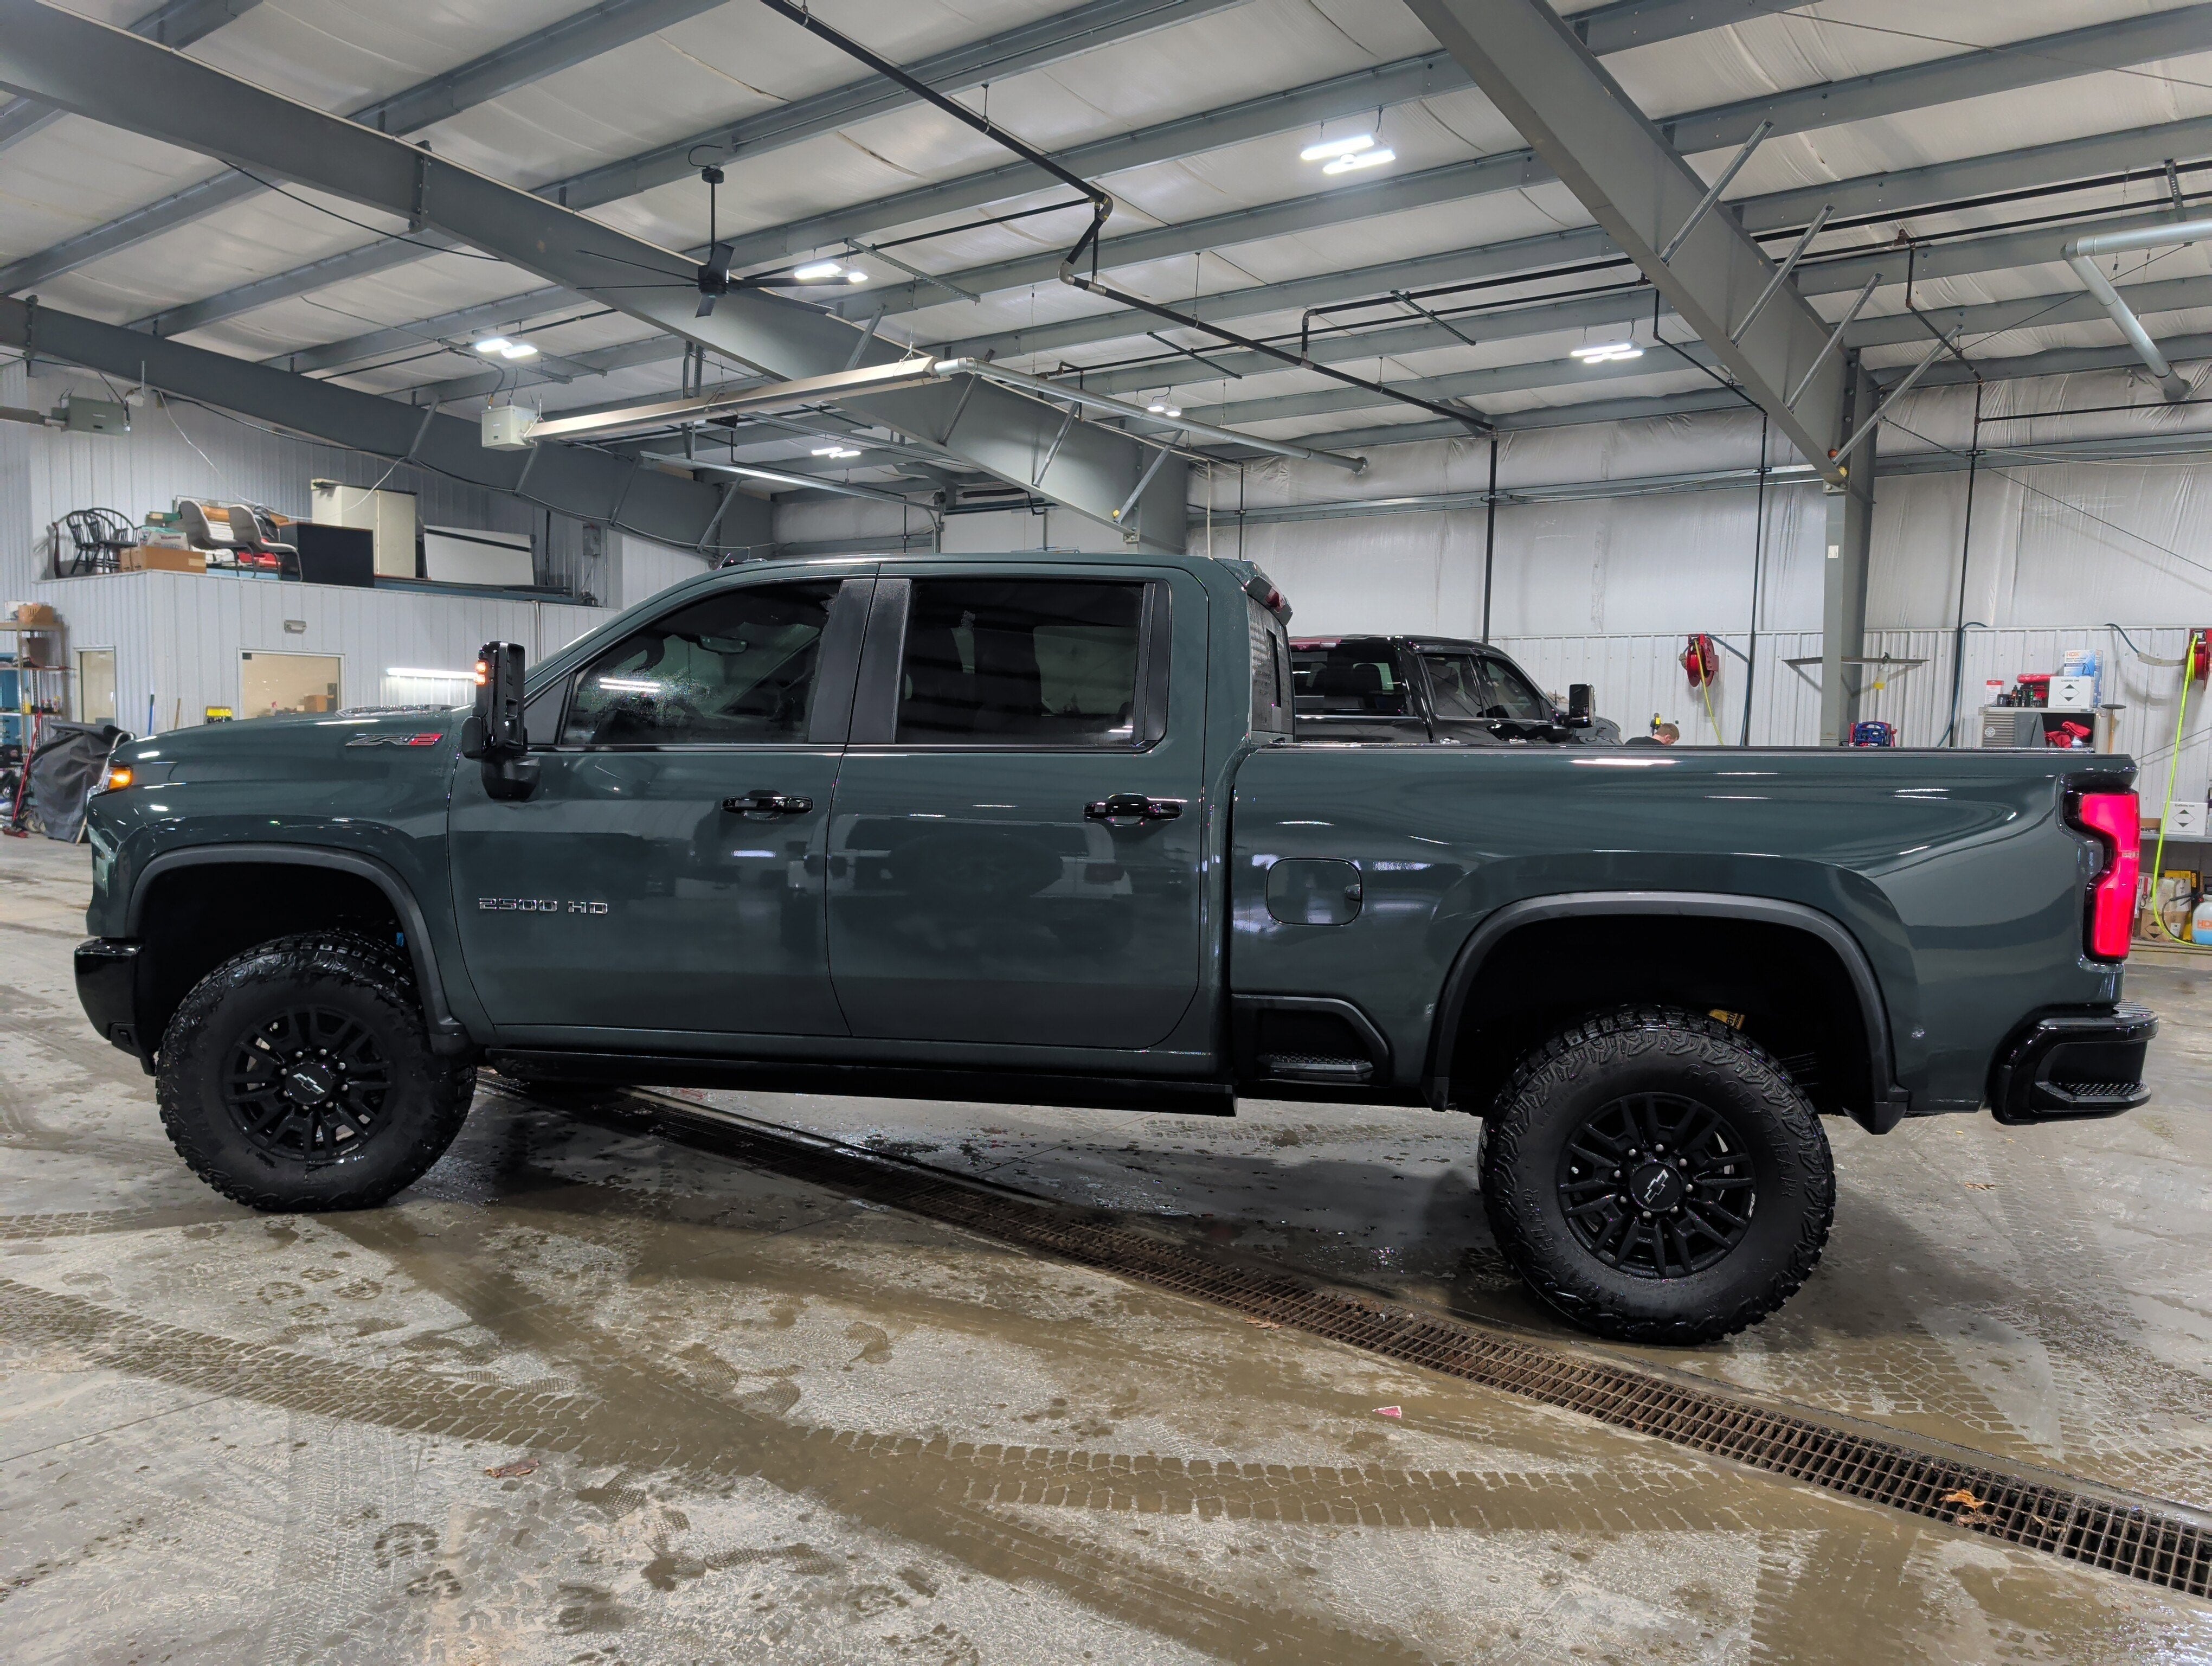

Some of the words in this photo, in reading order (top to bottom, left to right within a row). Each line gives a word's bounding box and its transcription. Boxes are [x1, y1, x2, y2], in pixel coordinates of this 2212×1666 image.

[345, 733, 443, 746] ZR2
[479, 898, 557, 912] 2500
[568, 901, 608, 914] HD
[2197, 920, 2212, 928] HD
[1684, 1063, 1798, 1199] GOODYEAR
